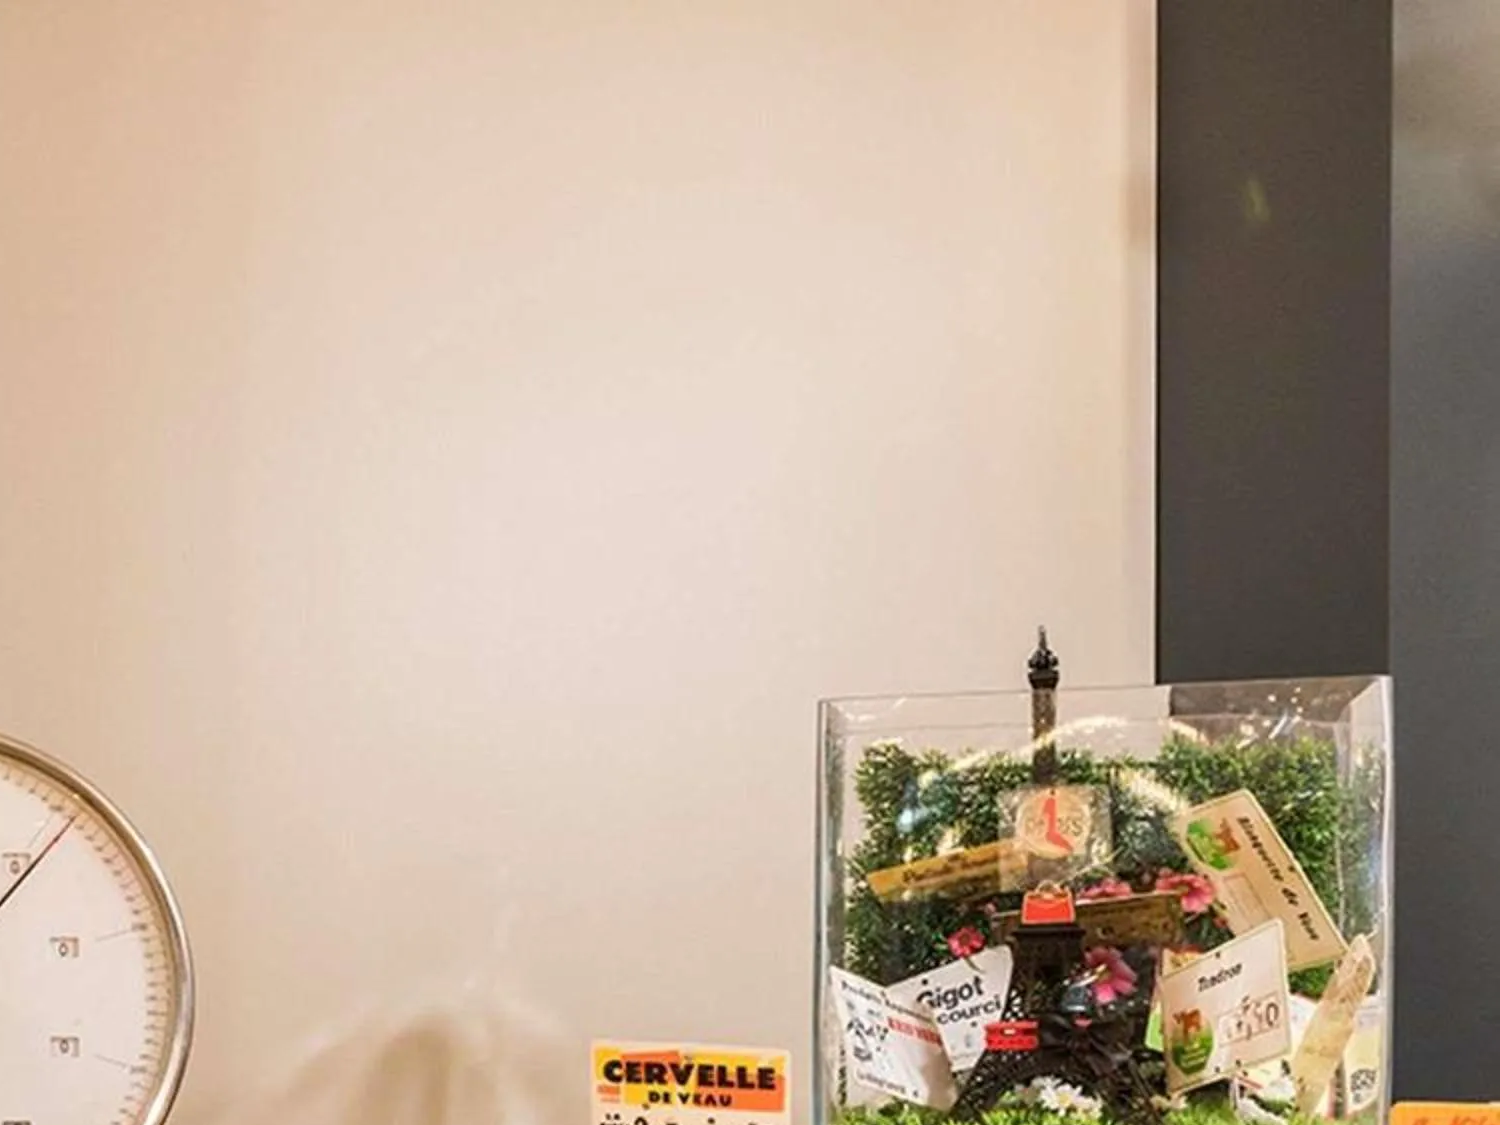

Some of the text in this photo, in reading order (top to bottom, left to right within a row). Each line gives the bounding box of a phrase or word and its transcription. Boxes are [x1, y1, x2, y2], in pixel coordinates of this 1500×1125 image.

[937, 994, 1002, 1025] courci
[603, 1059, 776, 1090] CERVELLE
[648, 1091, 733, 1107] DE VEAU
